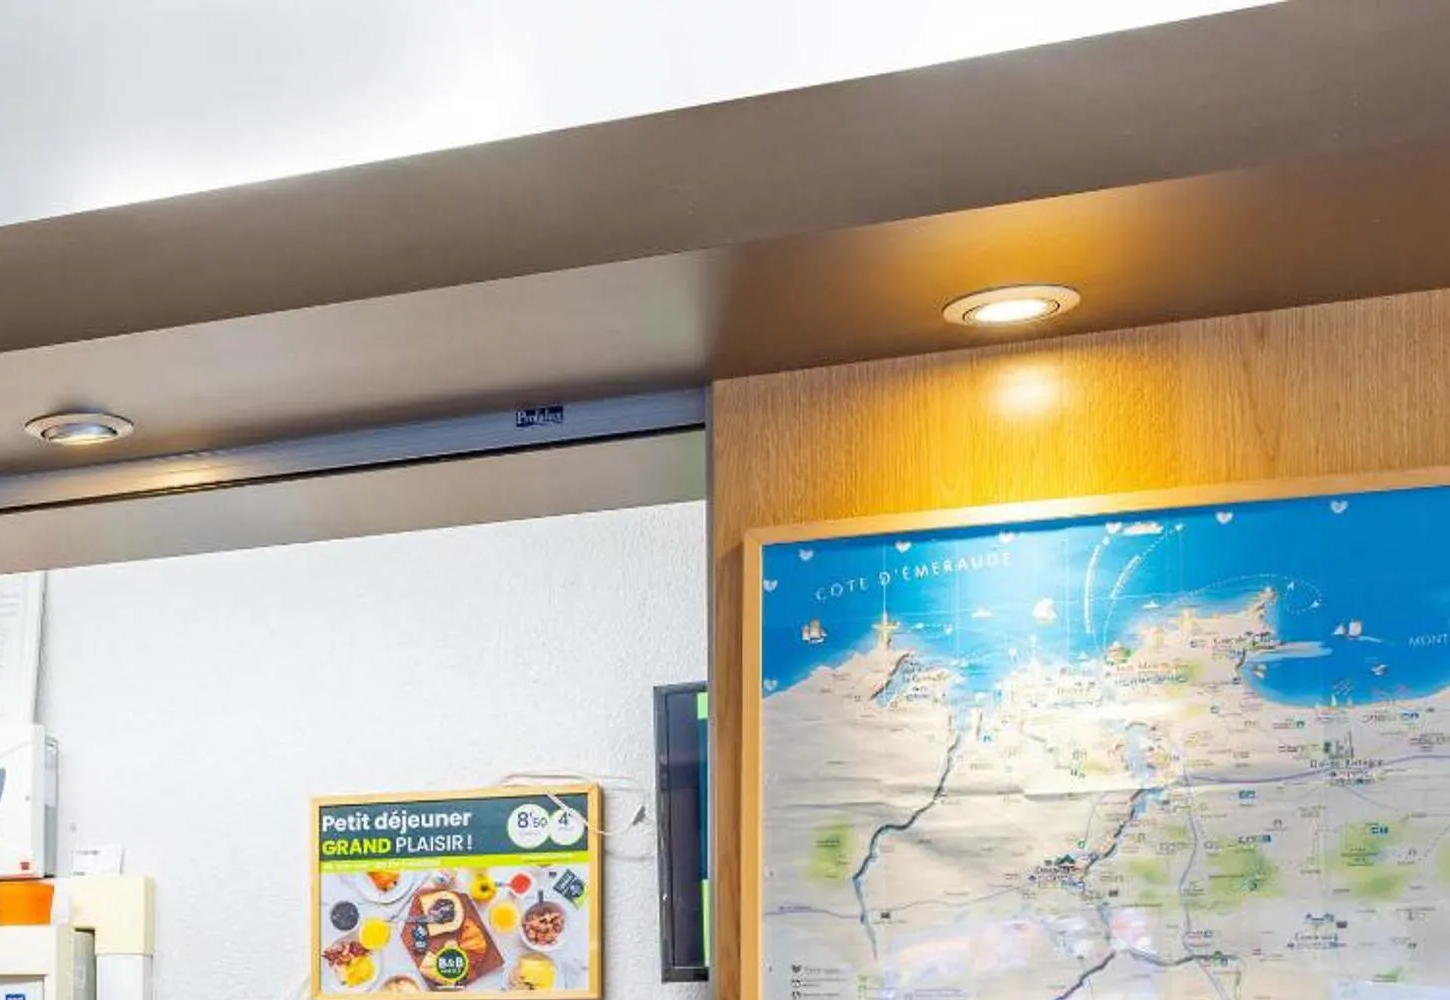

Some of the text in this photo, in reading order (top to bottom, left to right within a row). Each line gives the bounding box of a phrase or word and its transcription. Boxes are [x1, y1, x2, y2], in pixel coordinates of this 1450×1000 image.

[321, 810, 473, 834] Petit déjeuner
[321, 837, 392, 855] GRAND
[395, 834, 464, 853] PLAISIR
